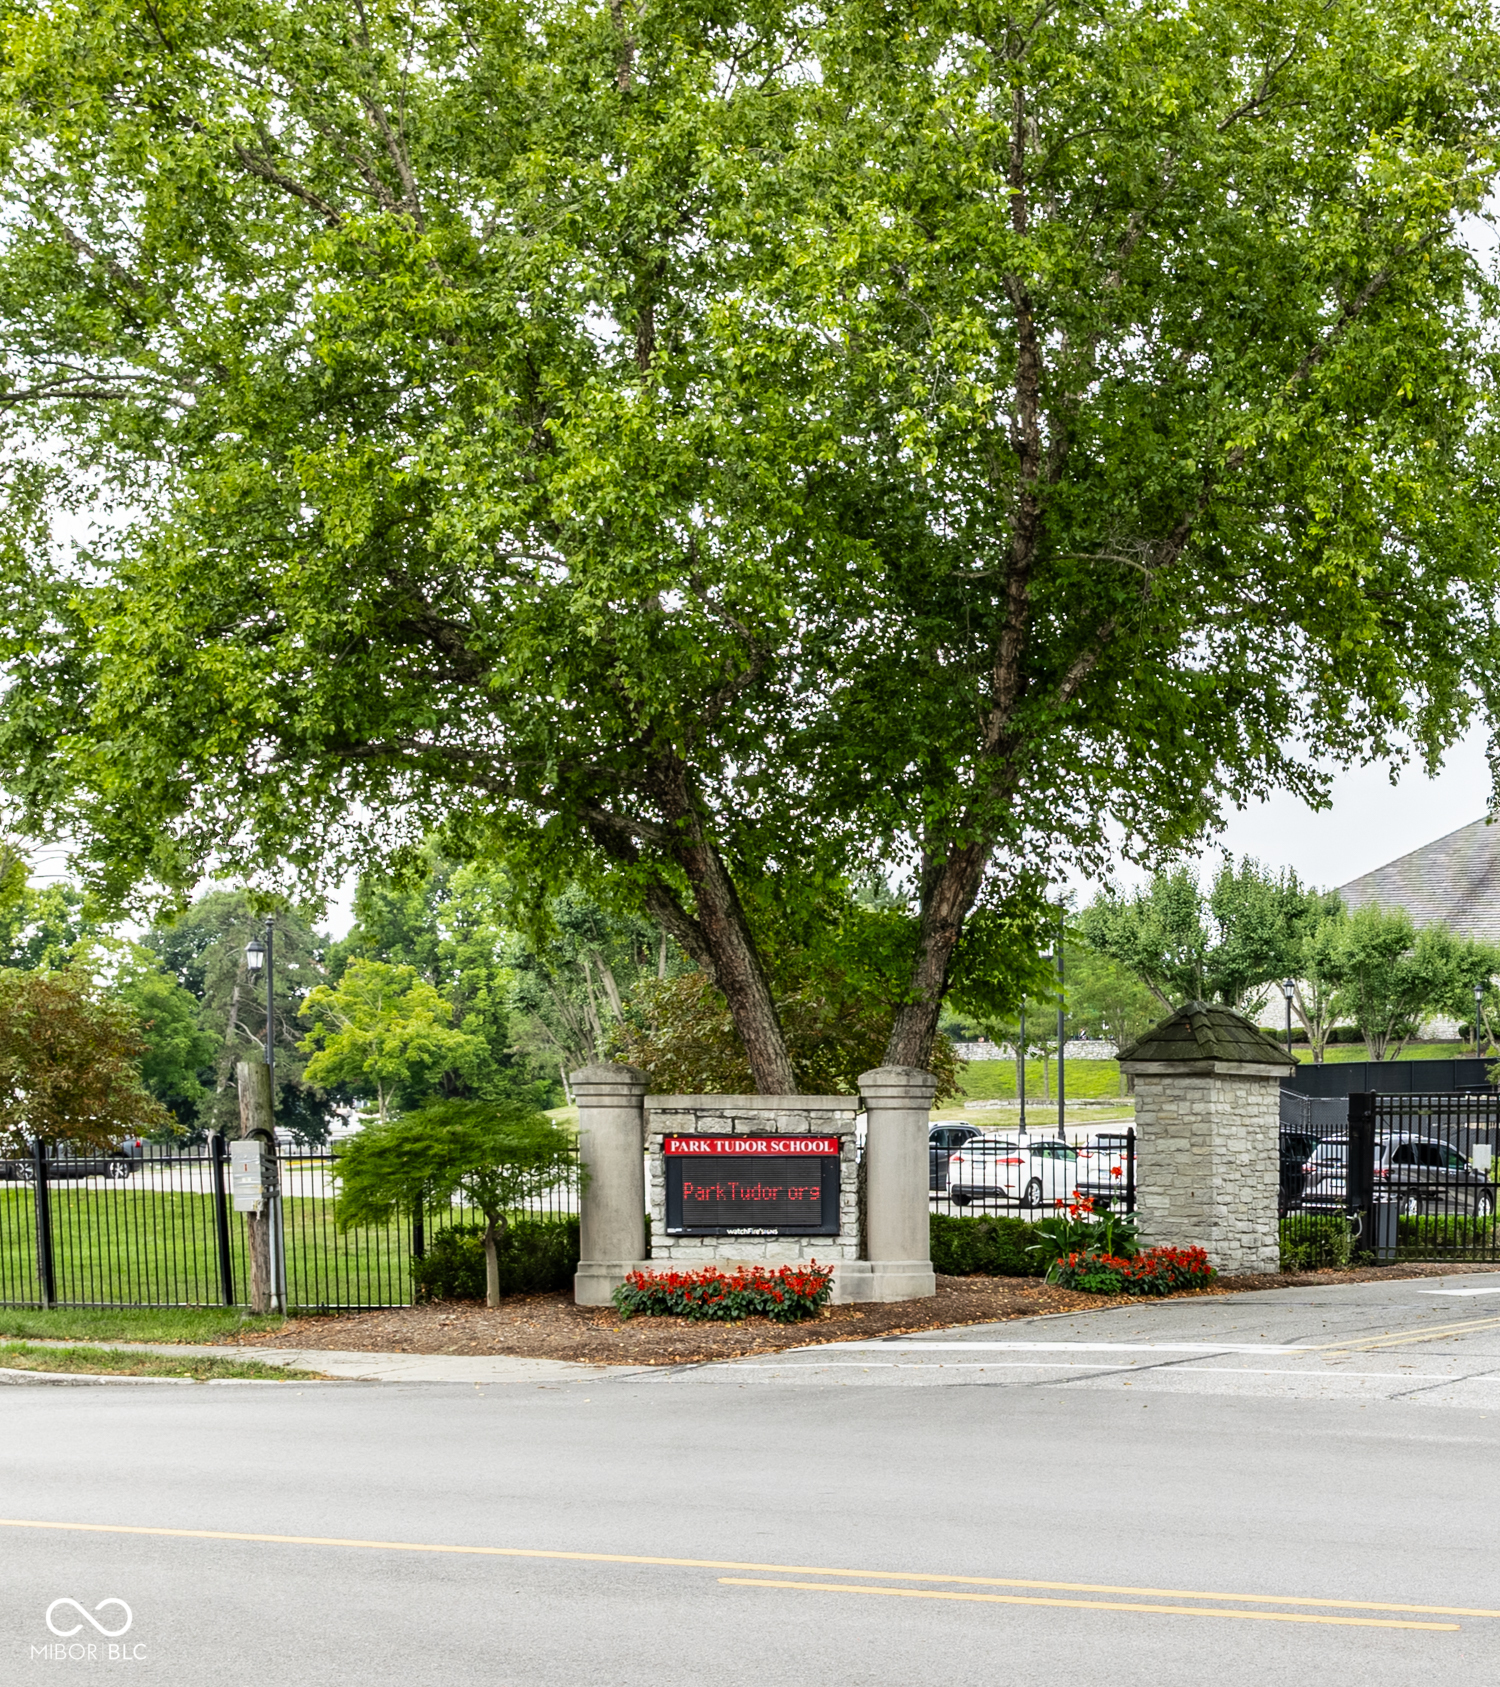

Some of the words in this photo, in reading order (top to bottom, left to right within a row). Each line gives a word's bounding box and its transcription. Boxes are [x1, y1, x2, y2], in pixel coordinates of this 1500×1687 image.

[670, 1140, 711, 1152] PARK
[714, 1140, 768, 1152] TUDOR
[770, 1140, 834, 1152] SCHOOL
[683, 1182, 821, 1201] ParkTudor.org
